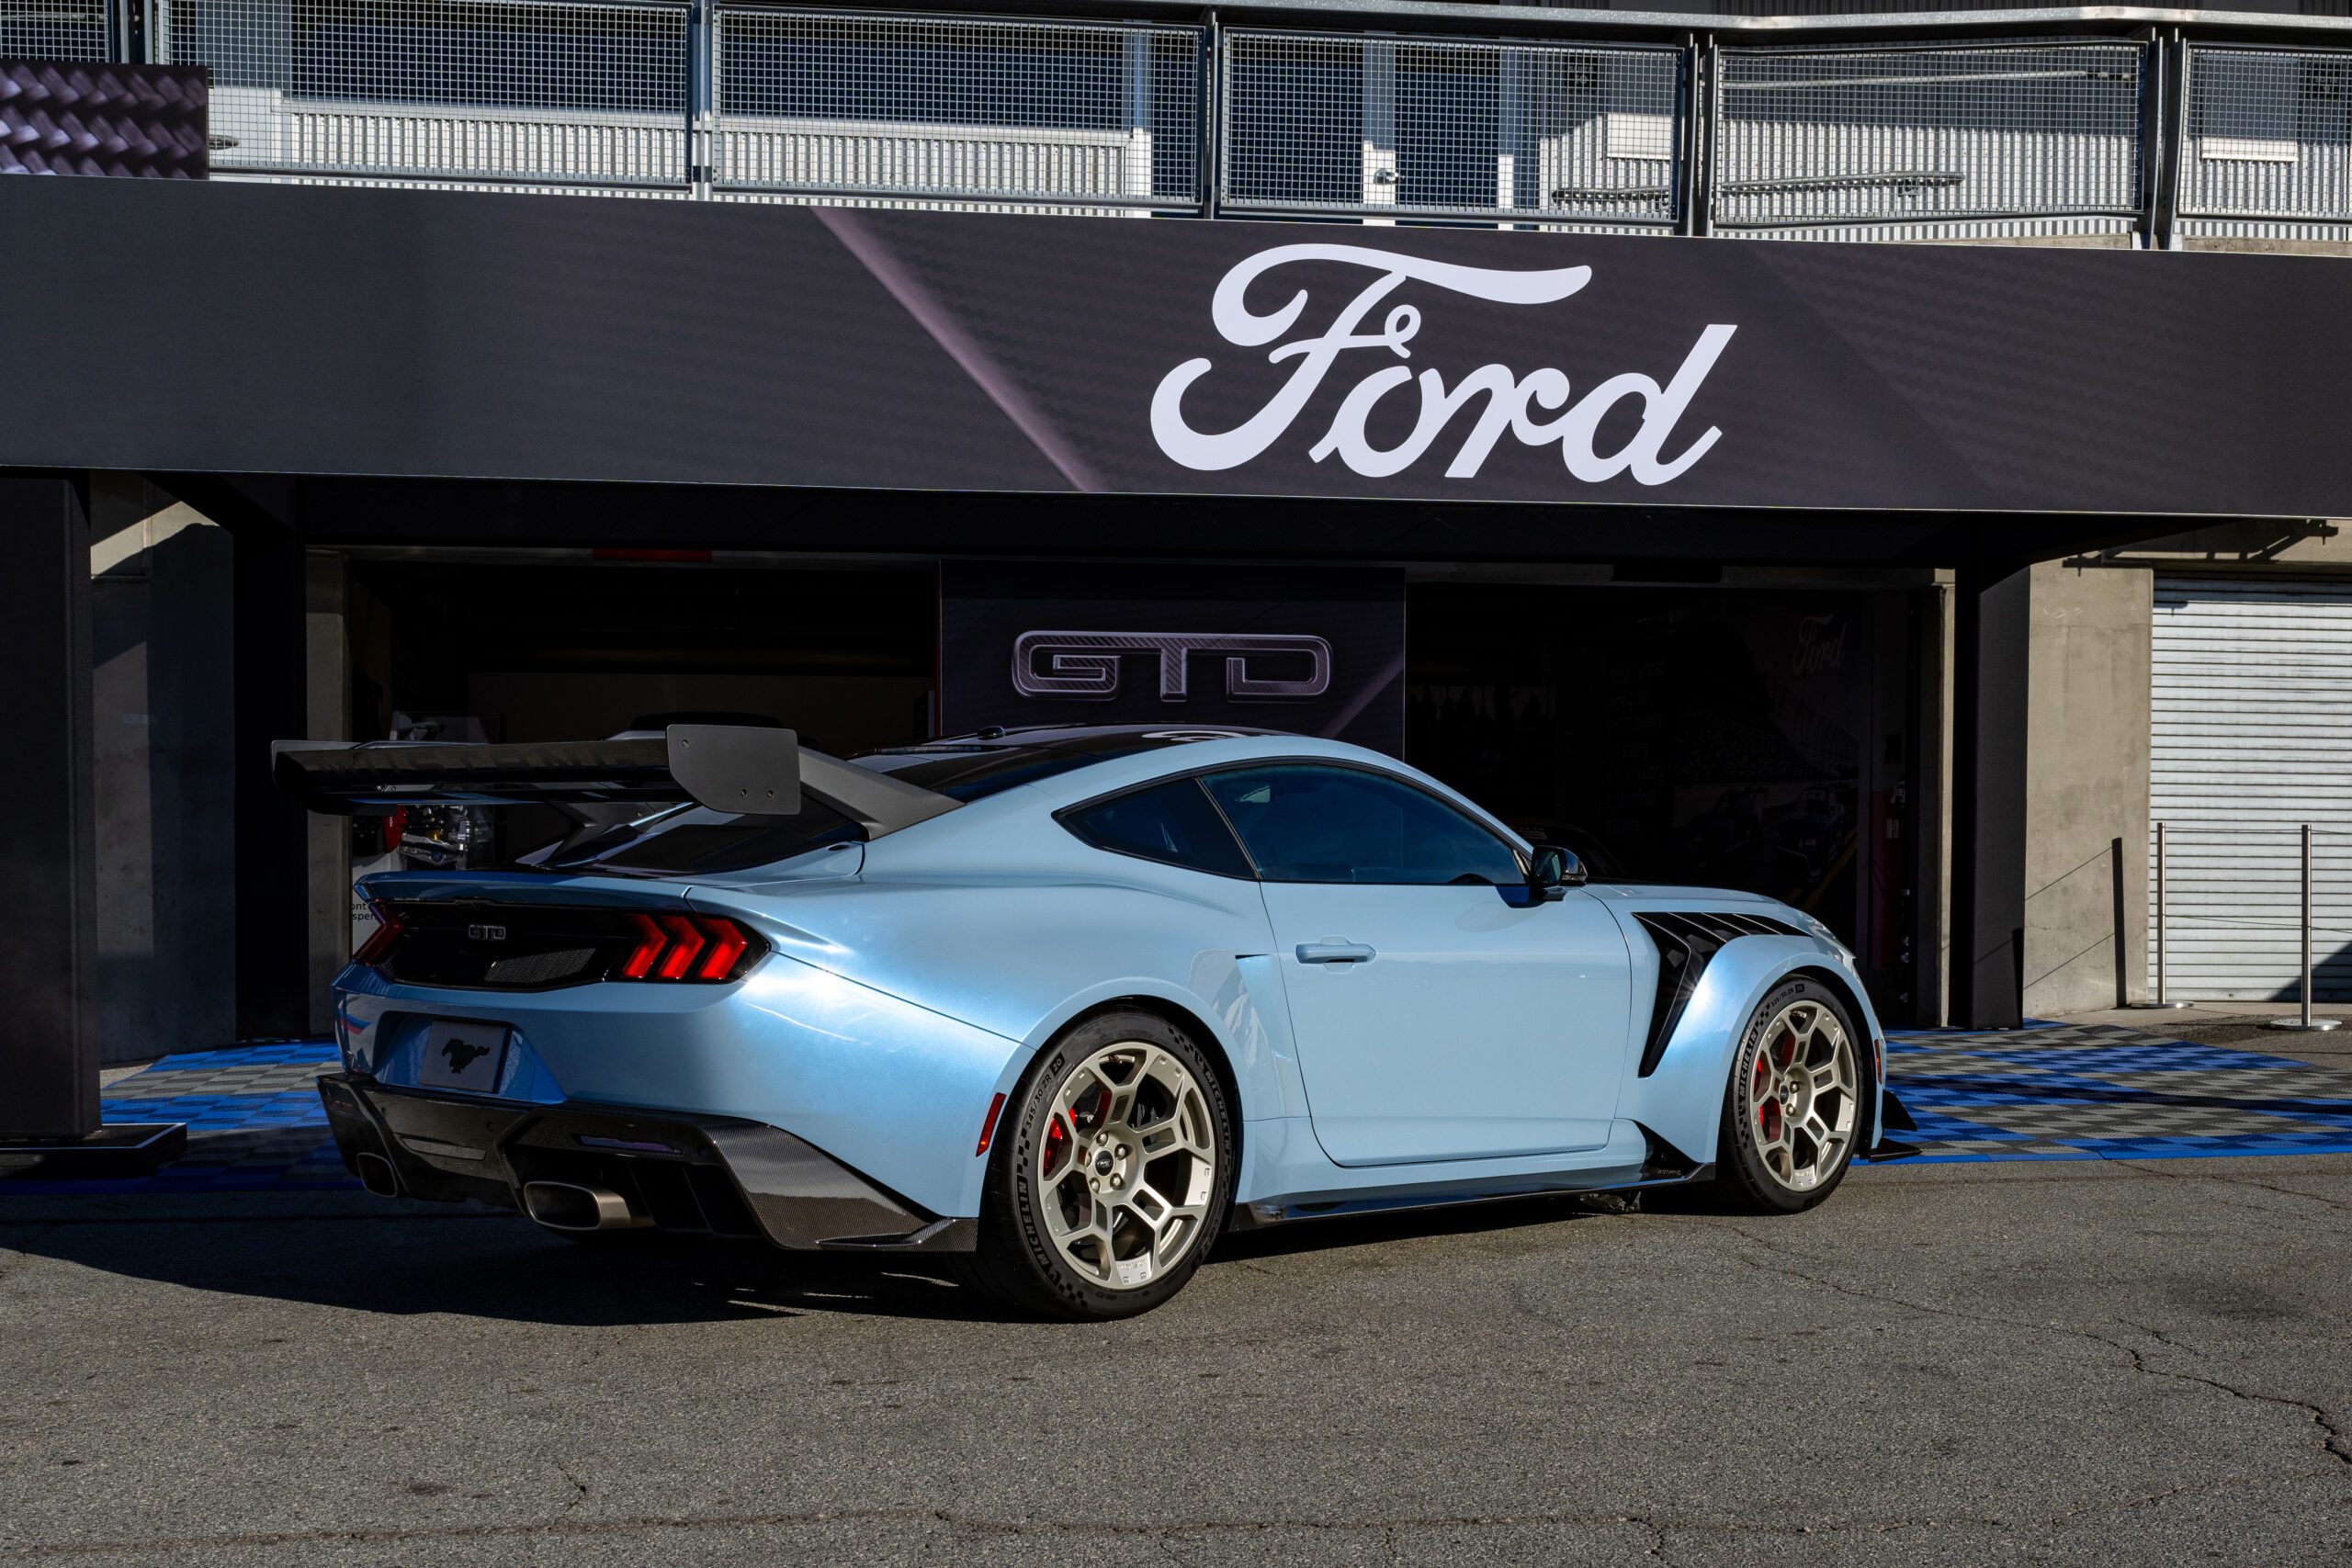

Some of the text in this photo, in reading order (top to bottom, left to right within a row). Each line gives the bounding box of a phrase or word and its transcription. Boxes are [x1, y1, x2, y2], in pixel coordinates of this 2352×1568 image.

[1150, 243, 1737, 486] Ford
[1012, 630, 1332, 702] GTD
[1793, 612, 1848, 676] Ford
[469, 924, 506, 941] GTD
[1026, 1058, 1063, 1129] 345/30 ZR 20
[1739, 1032, 1758, 1097] MICHELIN
[1205, 1070, 1230, 1147] MICHELIN
[1018, 1181, 1050, 1266] MICHELIN
